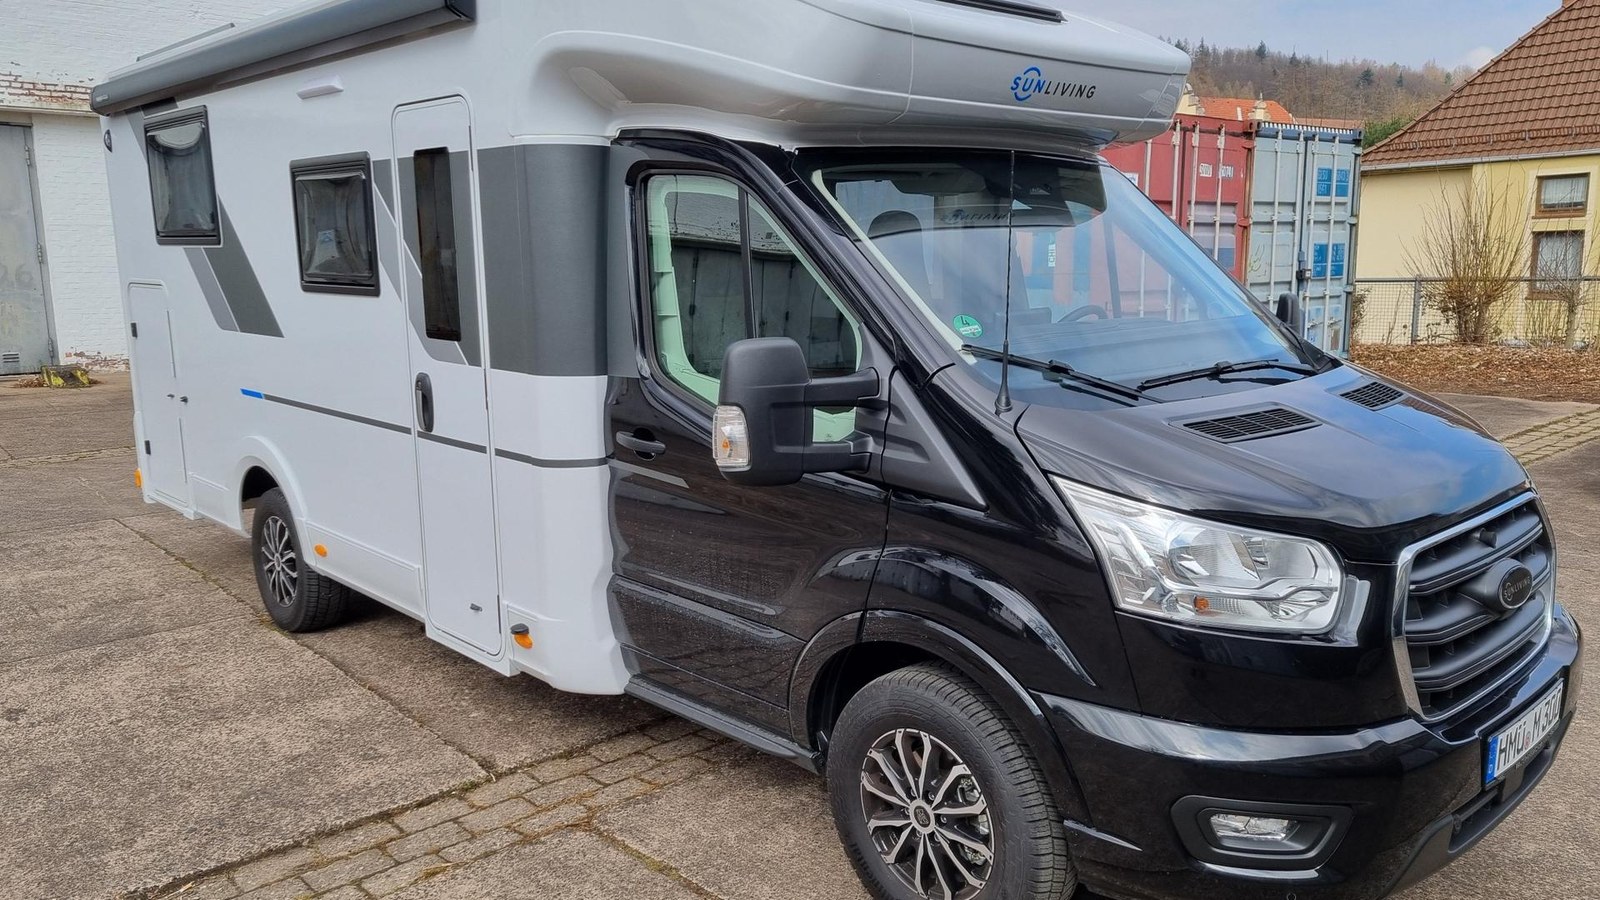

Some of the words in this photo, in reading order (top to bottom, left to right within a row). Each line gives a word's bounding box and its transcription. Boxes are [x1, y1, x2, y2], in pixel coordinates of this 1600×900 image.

[1010, 74, 1096, 99] SUNLIVING
[960, 315, 970, 326] 4
[1497, 720, 1527, 770] HMÜ
[1531, 707, 1542, 742] M
[1541, 687, 1561, 732] 300
